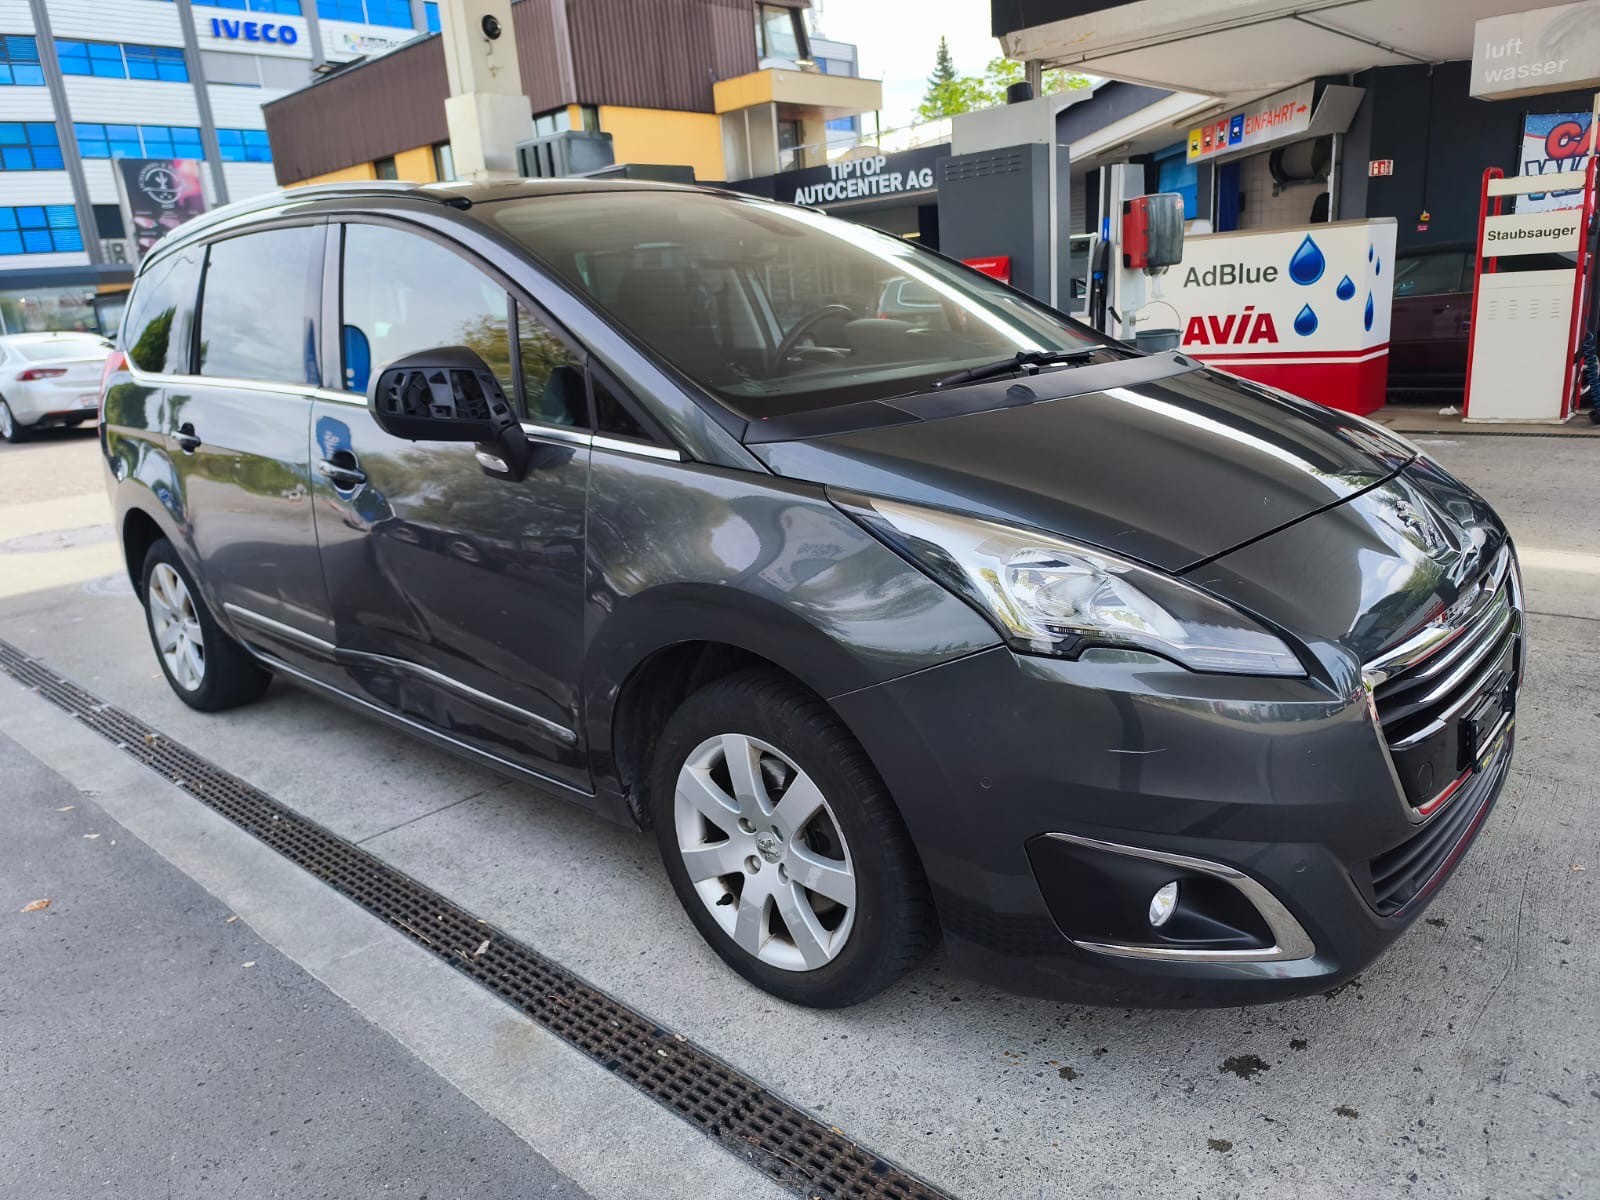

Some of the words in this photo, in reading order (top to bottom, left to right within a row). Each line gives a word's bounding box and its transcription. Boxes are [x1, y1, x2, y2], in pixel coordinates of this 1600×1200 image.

[211, 18, 298, 45] IVECO
[1485, 38, 1523, 59] luft
[1485, 59, 1568, 82] wasser
[1245, 101, 1296, 135] EINFAHRT
[828, 155, 886, 180] TIPTOP
[794, 173, 903, 205] AUTOCENTER
[906, 168, 933, 190] AG
[1487, 226, 1577, 241] Staubsauger
[1183, 263, 1278, 288] AdBlue
